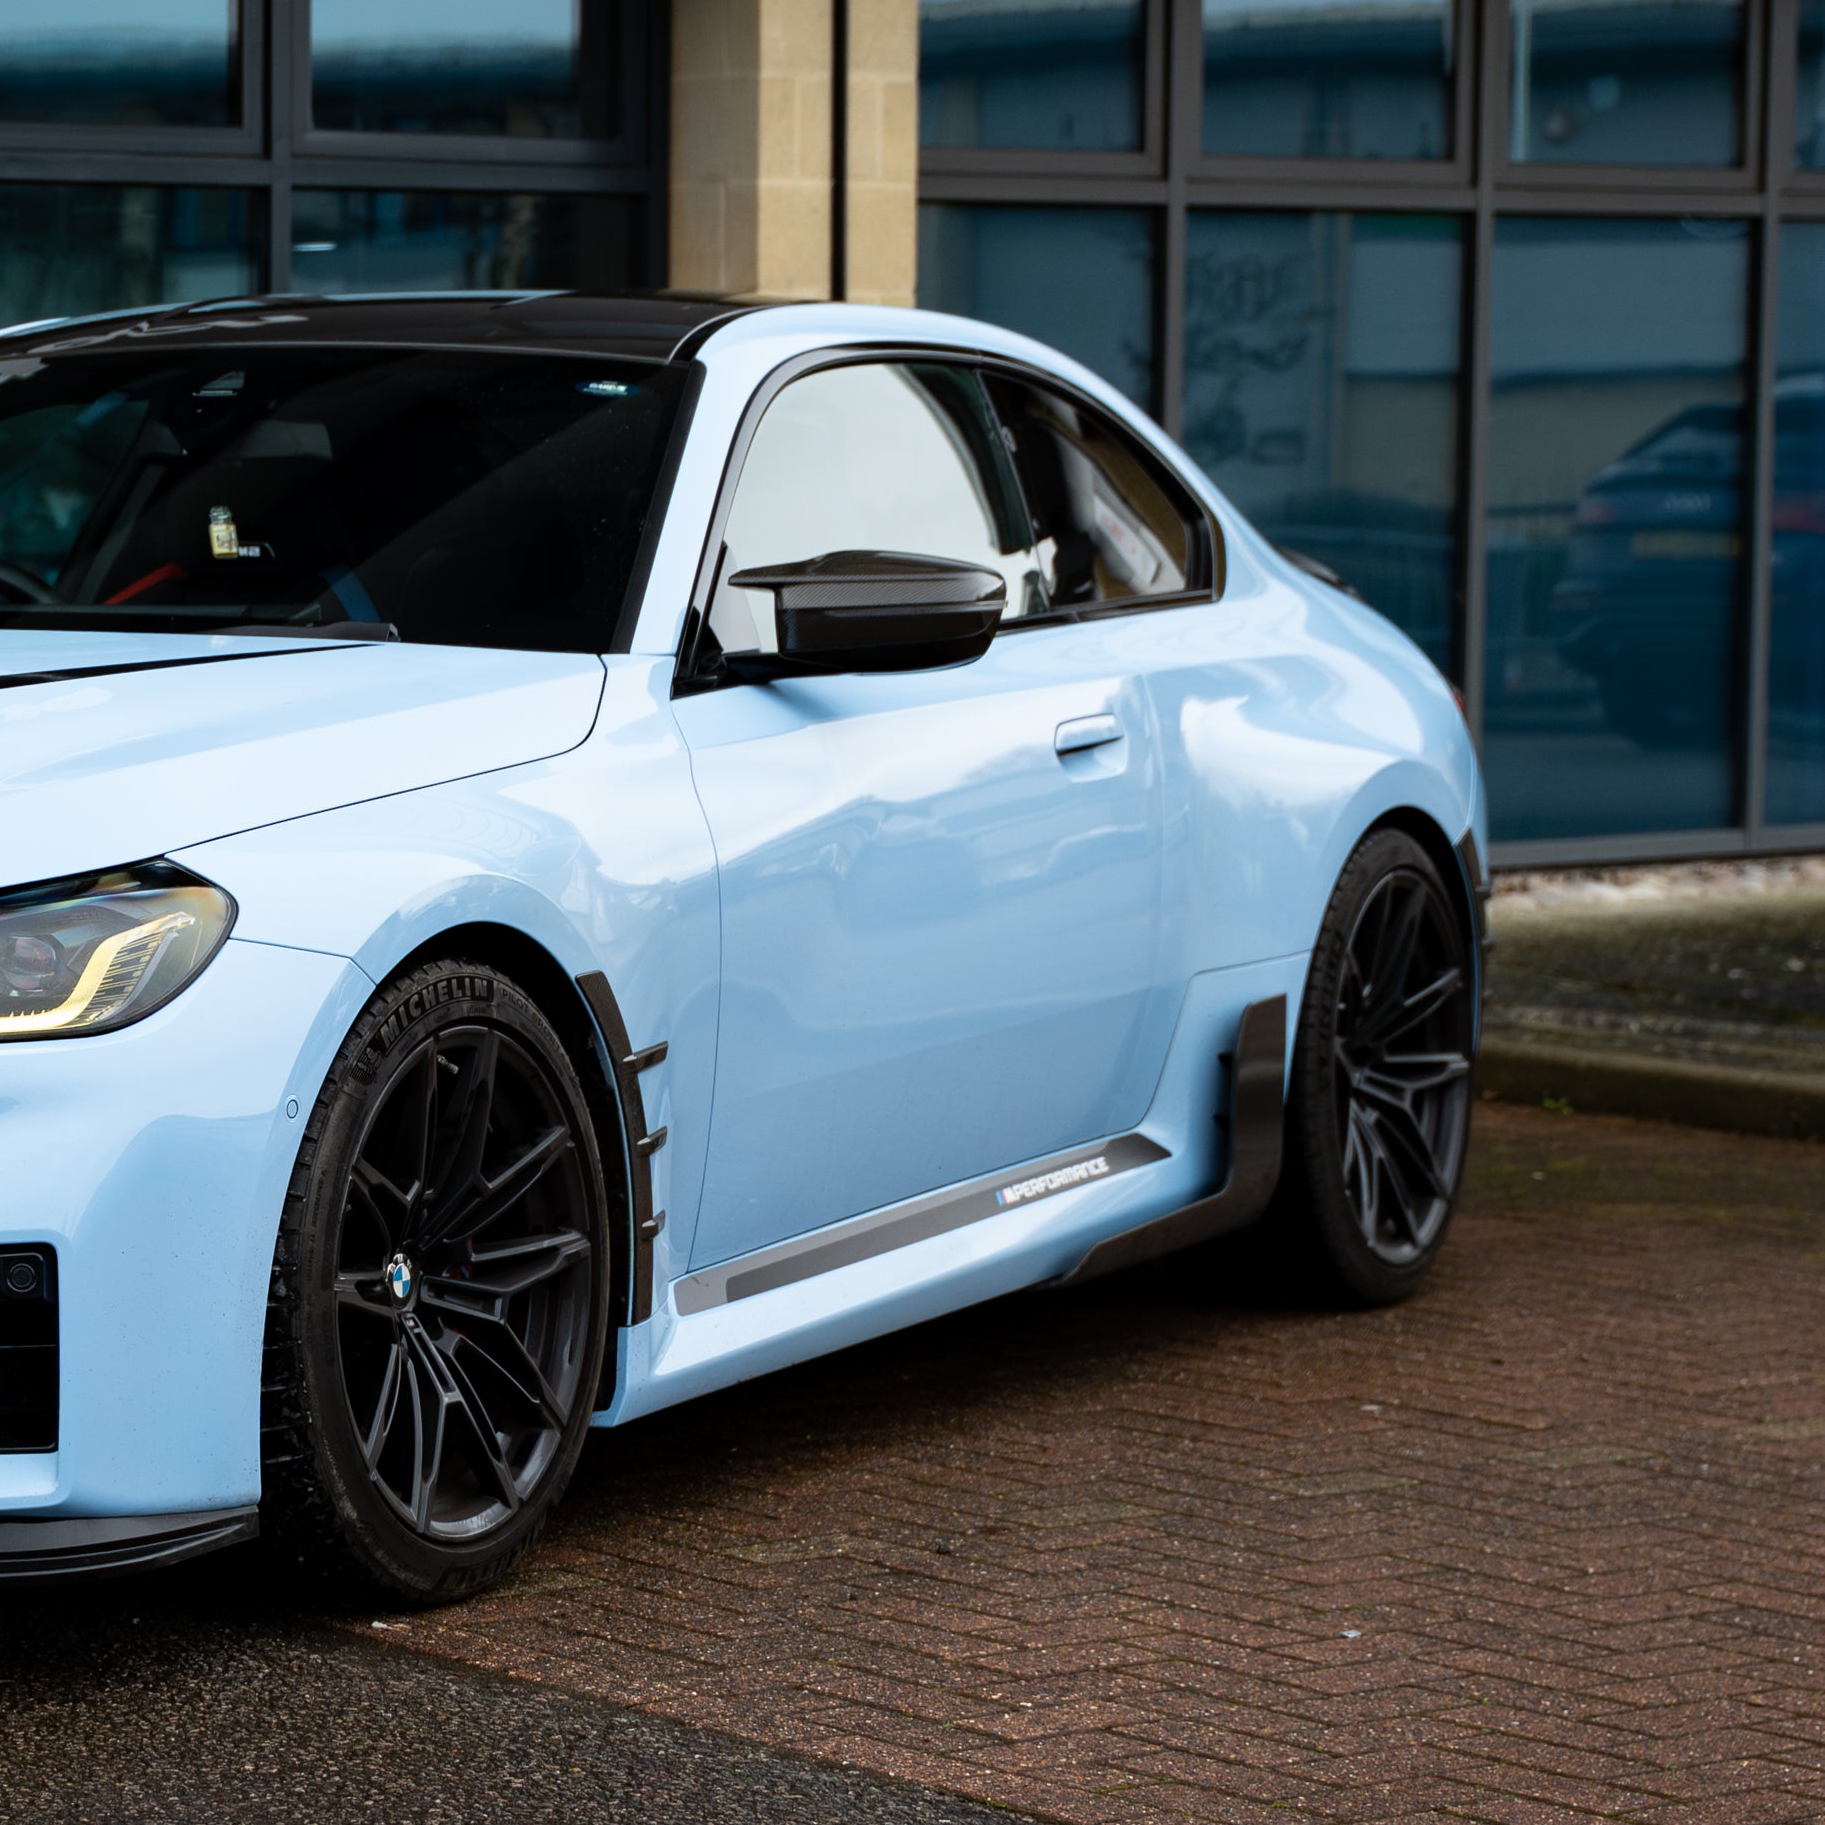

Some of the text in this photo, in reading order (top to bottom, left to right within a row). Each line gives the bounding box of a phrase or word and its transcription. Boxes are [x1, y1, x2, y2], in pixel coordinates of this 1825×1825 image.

[380, 976, 488, 1047] MICHELIN
[501, 987, 531, 1014] PILOT
[1012, 1156, 1110, 1200] PERFORMANCE
